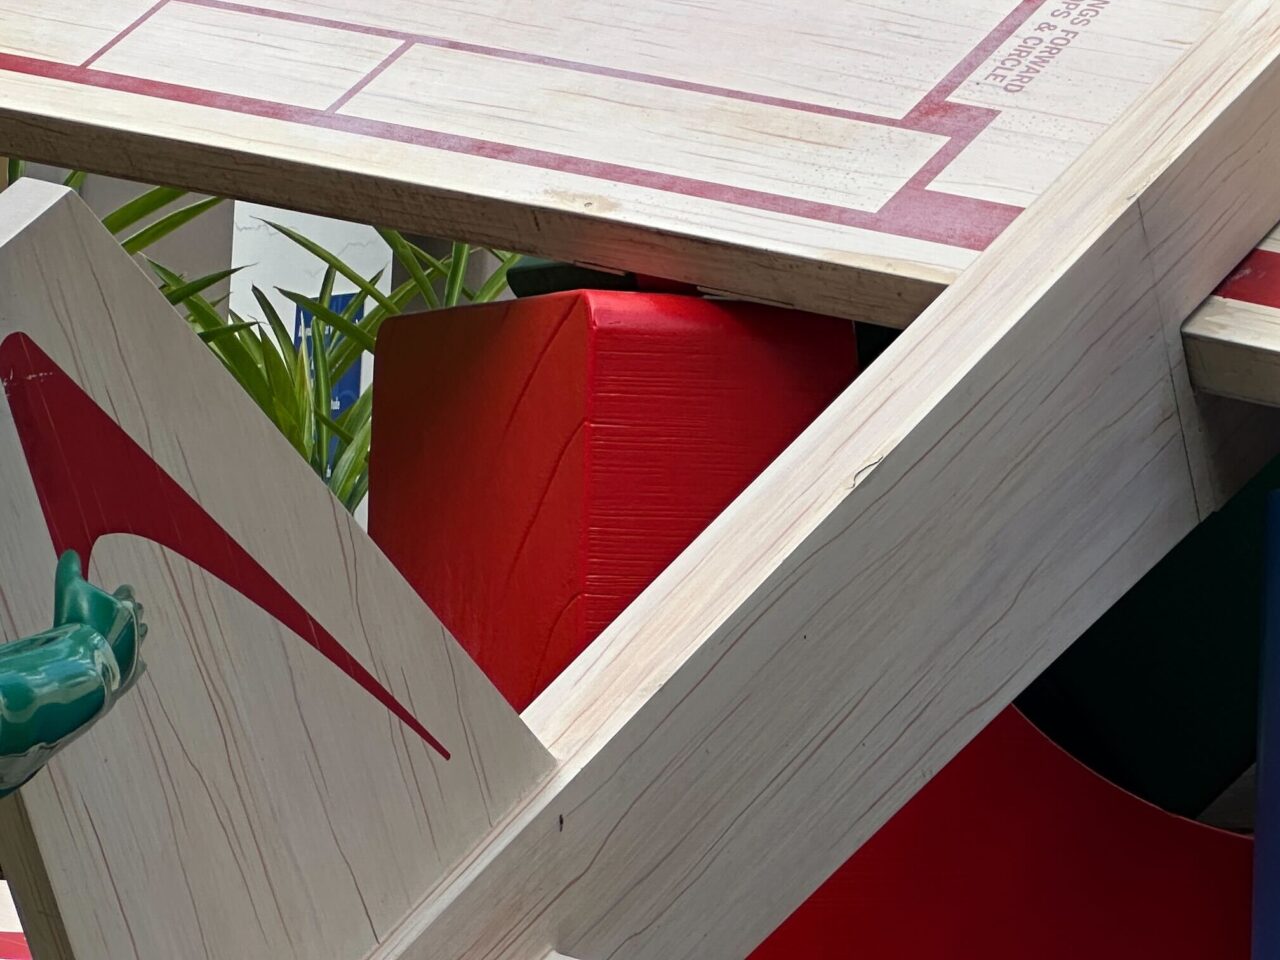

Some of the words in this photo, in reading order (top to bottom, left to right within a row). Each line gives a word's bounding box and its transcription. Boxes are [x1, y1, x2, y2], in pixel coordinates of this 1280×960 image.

[1034, 21, 1058, 32] &
[984, 36, 1044, 83] CIRCLE
[1003, 28, 1079, 93] FORWARD
